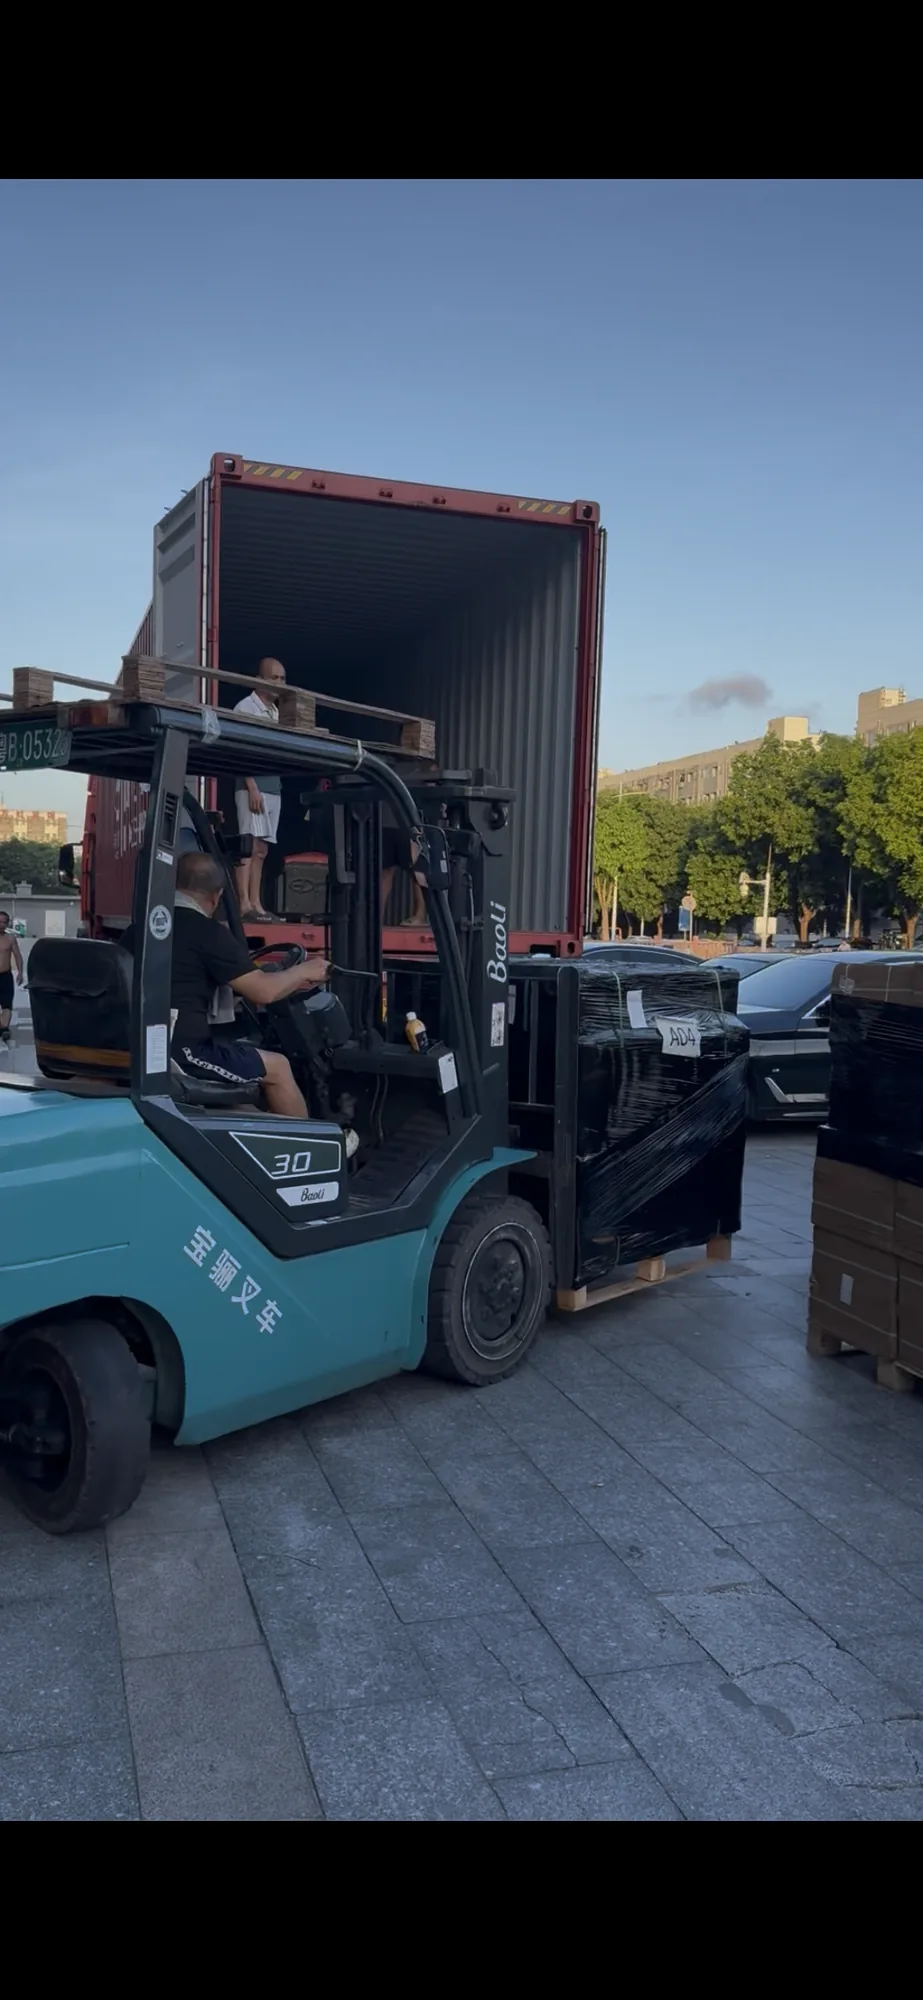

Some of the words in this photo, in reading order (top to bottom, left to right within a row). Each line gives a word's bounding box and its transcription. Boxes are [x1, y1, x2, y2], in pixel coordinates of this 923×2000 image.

[486, 901, 507, 983] Baoli
[271, 1151, 312, 1175] 30
[300, 1187, 326, 1202] Baoli
[183, 1225, 283, 1334] 宝骊叉车
